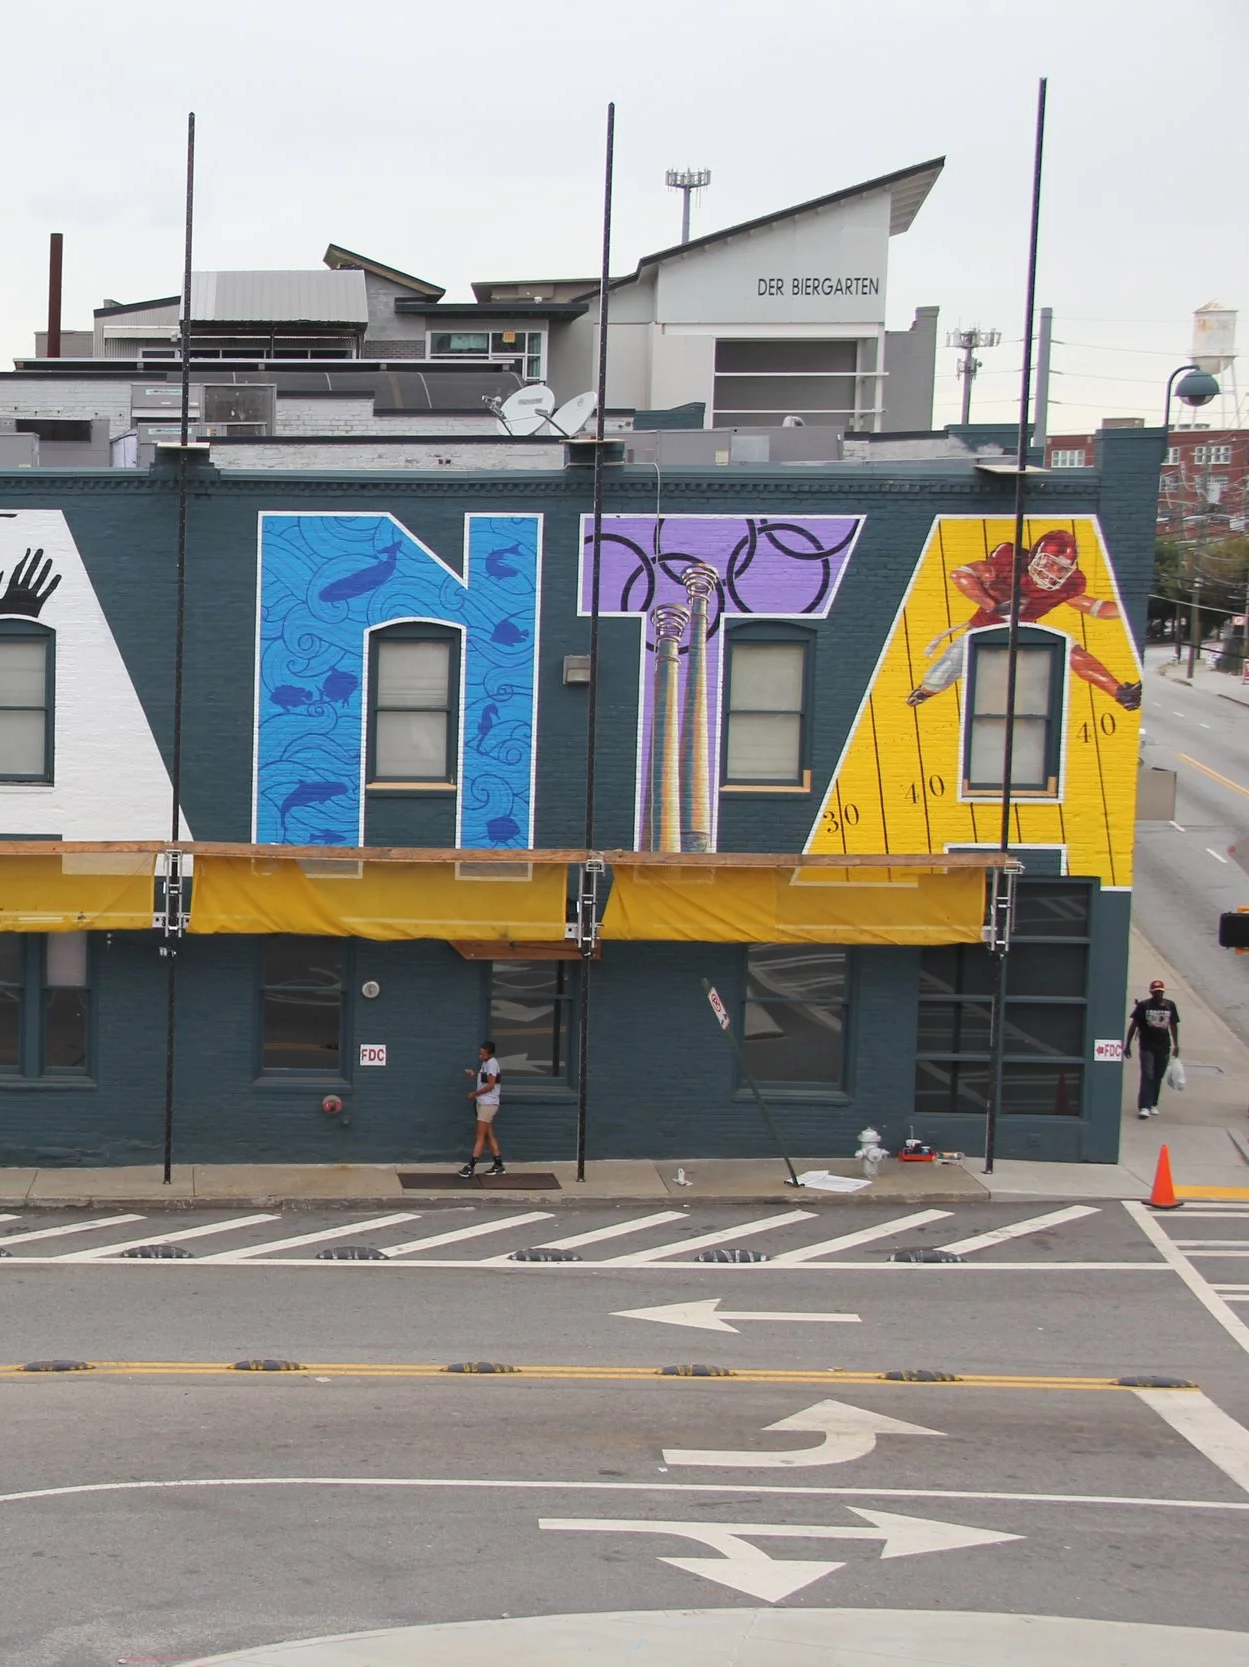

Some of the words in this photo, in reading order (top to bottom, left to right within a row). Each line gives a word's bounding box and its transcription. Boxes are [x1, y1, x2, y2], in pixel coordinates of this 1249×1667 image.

[757, 278, 784, 296] DER
[791, 277, 879, 296] BIERGARTEN
[361, 1048, 385, 1062] FDC
[1104, 1044, 1123, 1058] FDC
